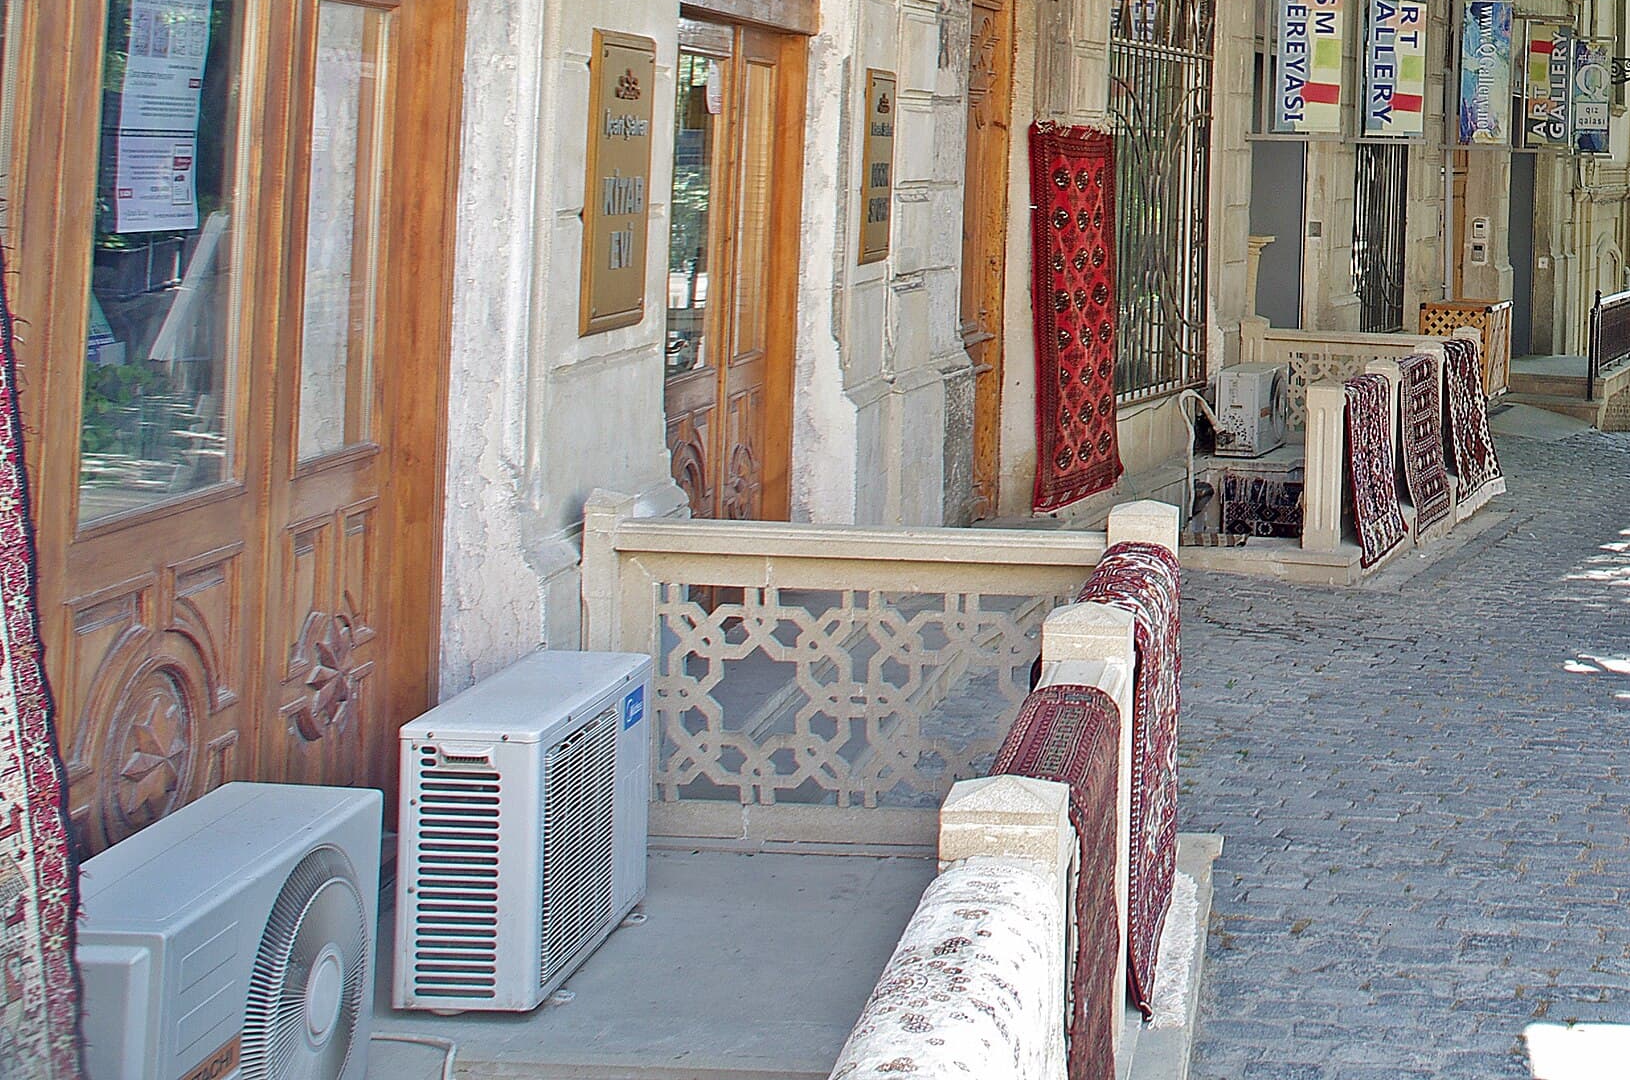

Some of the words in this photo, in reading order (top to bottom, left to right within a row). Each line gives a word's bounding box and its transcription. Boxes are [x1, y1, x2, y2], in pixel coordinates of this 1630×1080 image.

[1550, 32, 1567, 138] GALLERY
[1533, 86, 1547, 137] ART
[604, 168, 643, 216] KİTAB
[610, 222, 634, 270] EVİ
